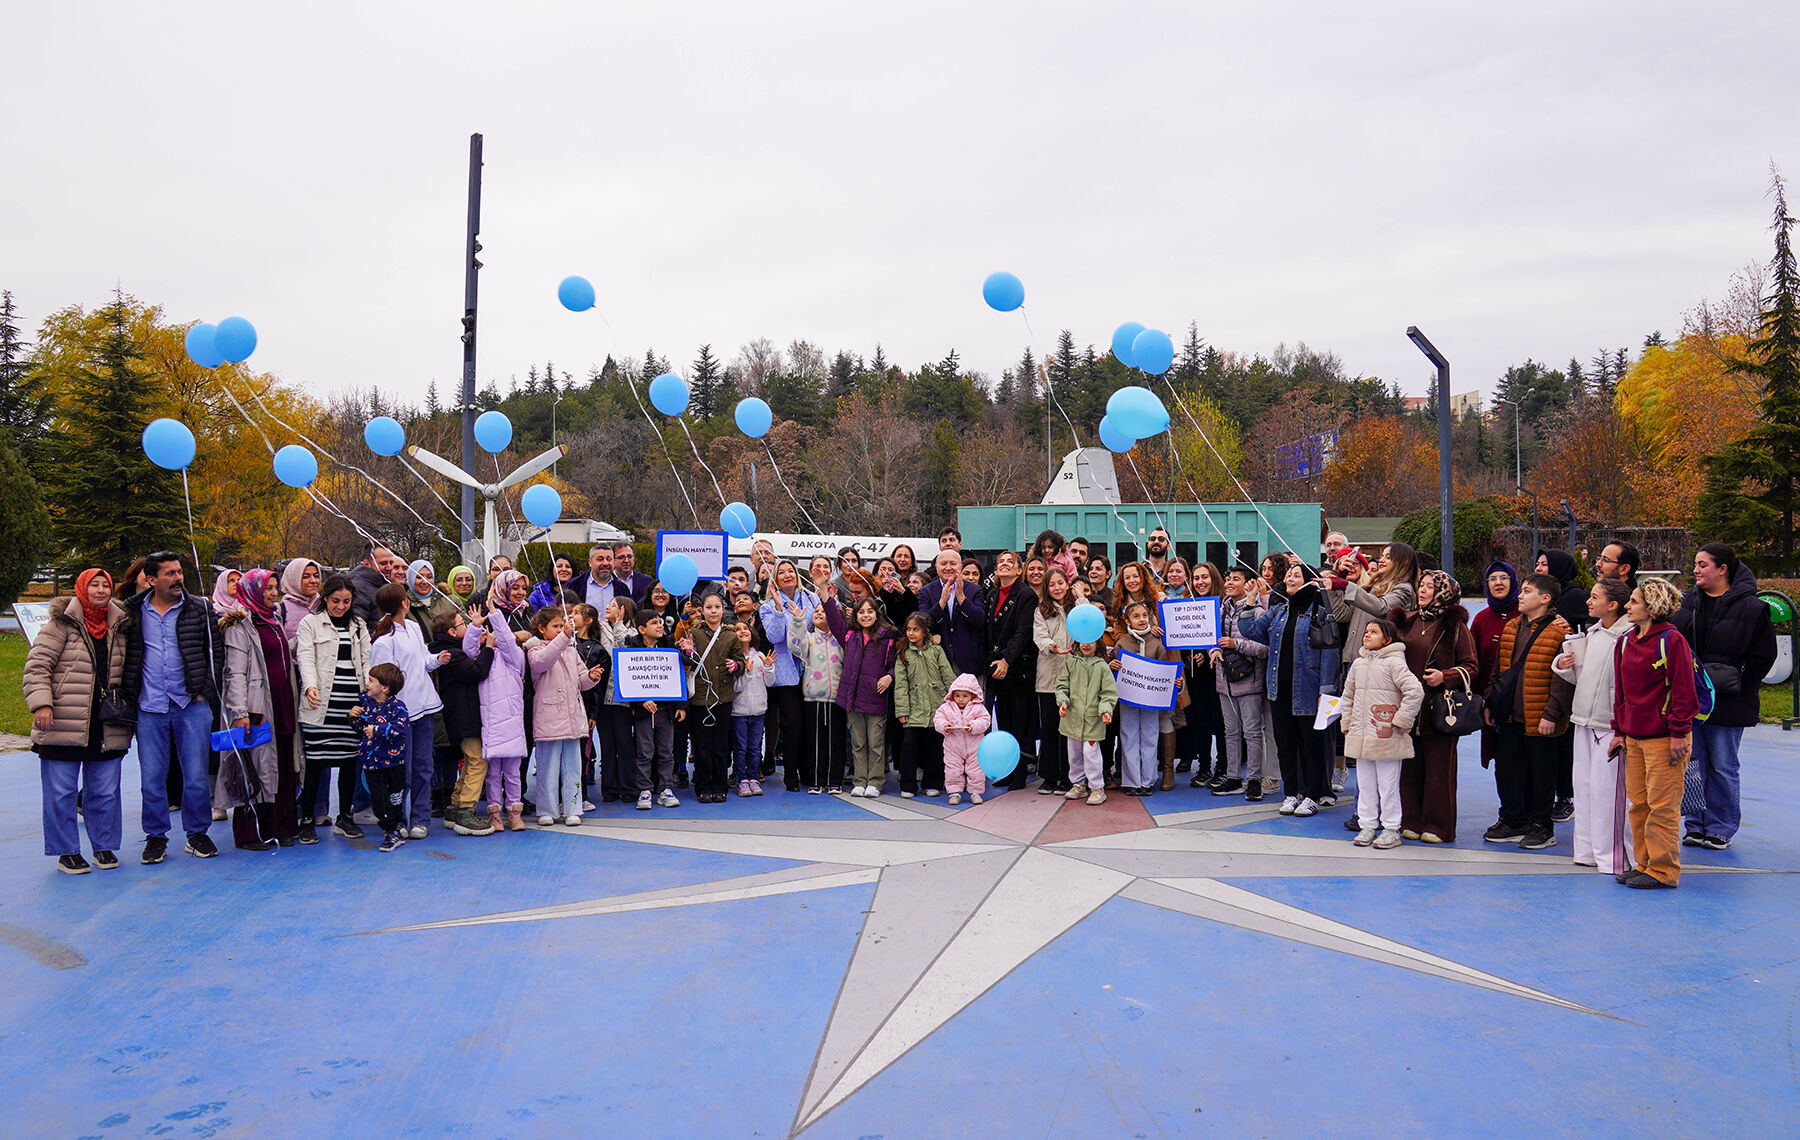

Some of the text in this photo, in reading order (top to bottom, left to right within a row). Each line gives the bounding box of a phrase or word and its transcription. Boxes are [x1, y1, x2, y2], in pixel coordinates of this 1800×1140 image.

[791, 541, 888, 553] DAKOTA C-47
[1127, 669, 1144, 679] BENİM
[1121, 677, 1145, 689] KONTROL
